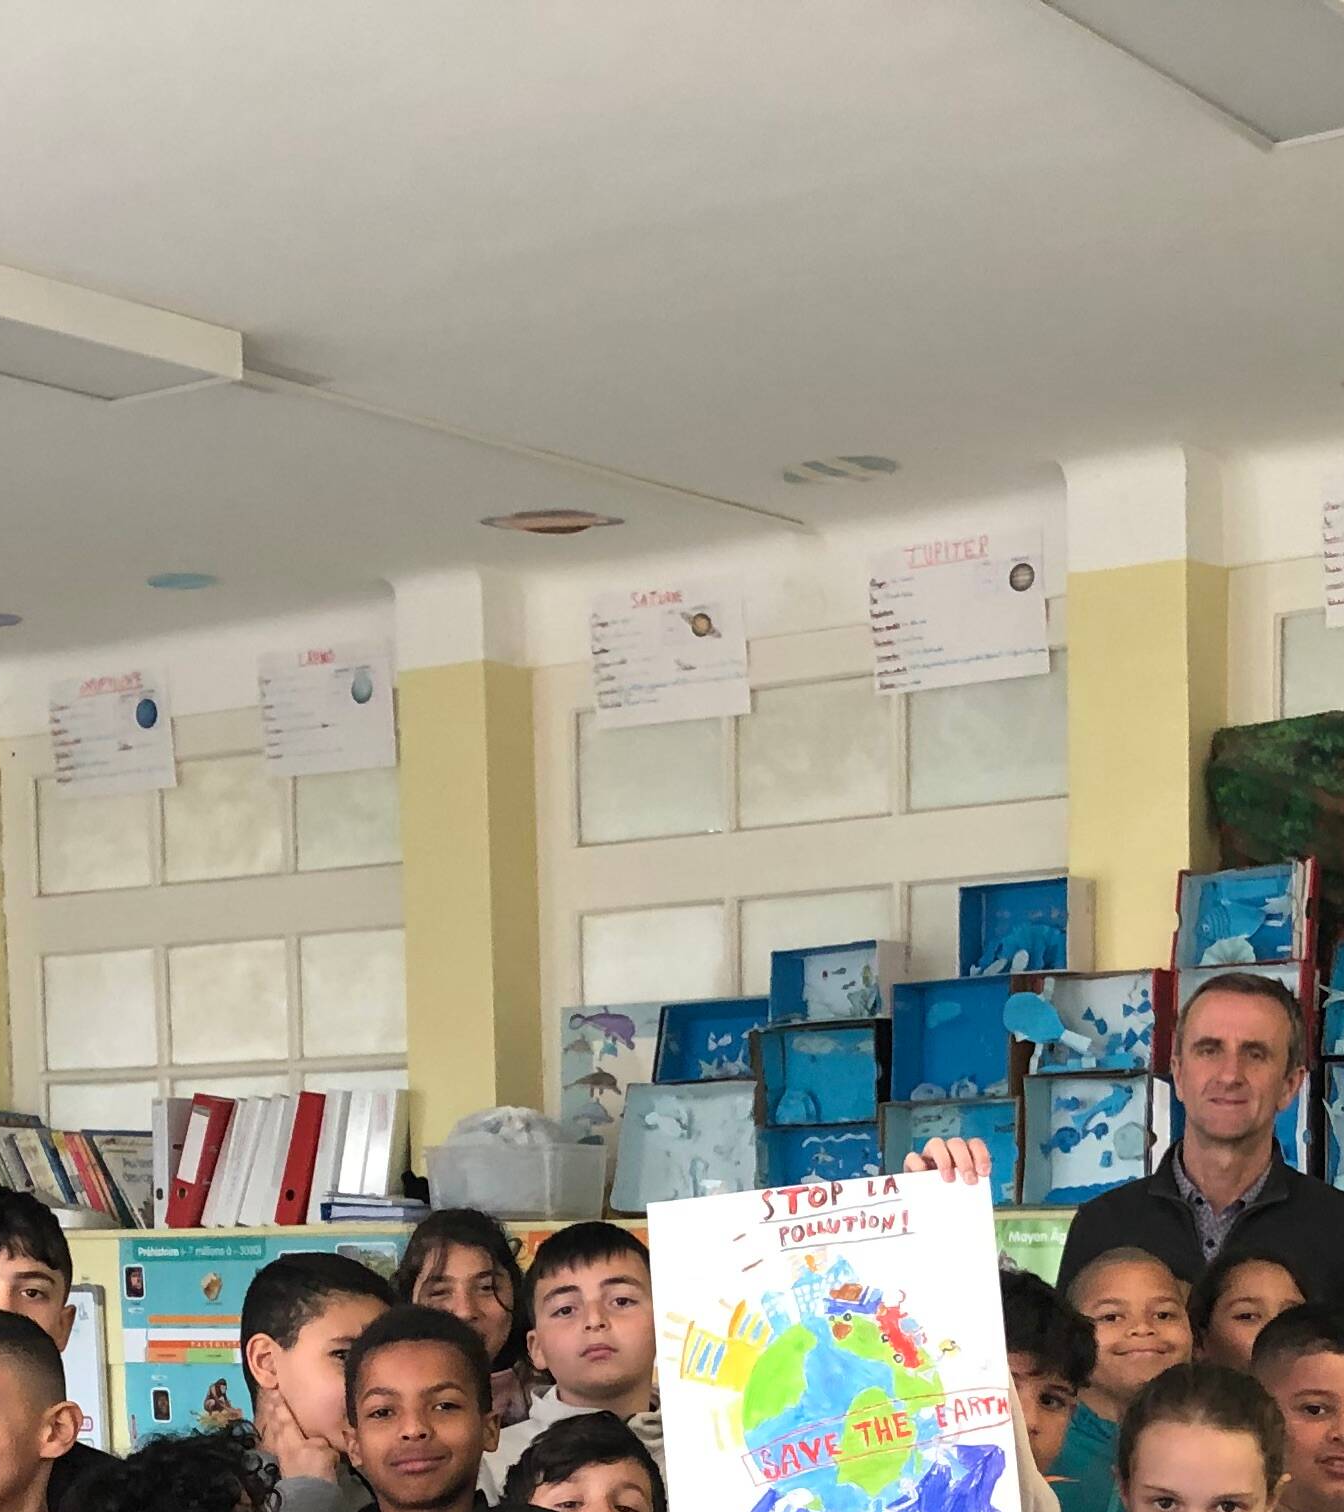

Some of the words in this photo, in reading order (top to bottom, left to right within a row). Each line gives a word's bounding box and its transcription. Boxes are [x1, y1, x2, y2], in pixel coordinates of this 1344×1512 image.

[903, 536, 990, 568] JUPITER
[762, 1181, 843, 1221] STOP
[867, 1175, 899, 1195] LA
[1008, 1232, 1048, 1244] Moyen
[760, 1432, 842, 1480] SAVE
[853, 1410, 913, 1447] THE
[935, 1395, 1009, 1428] EARTH
